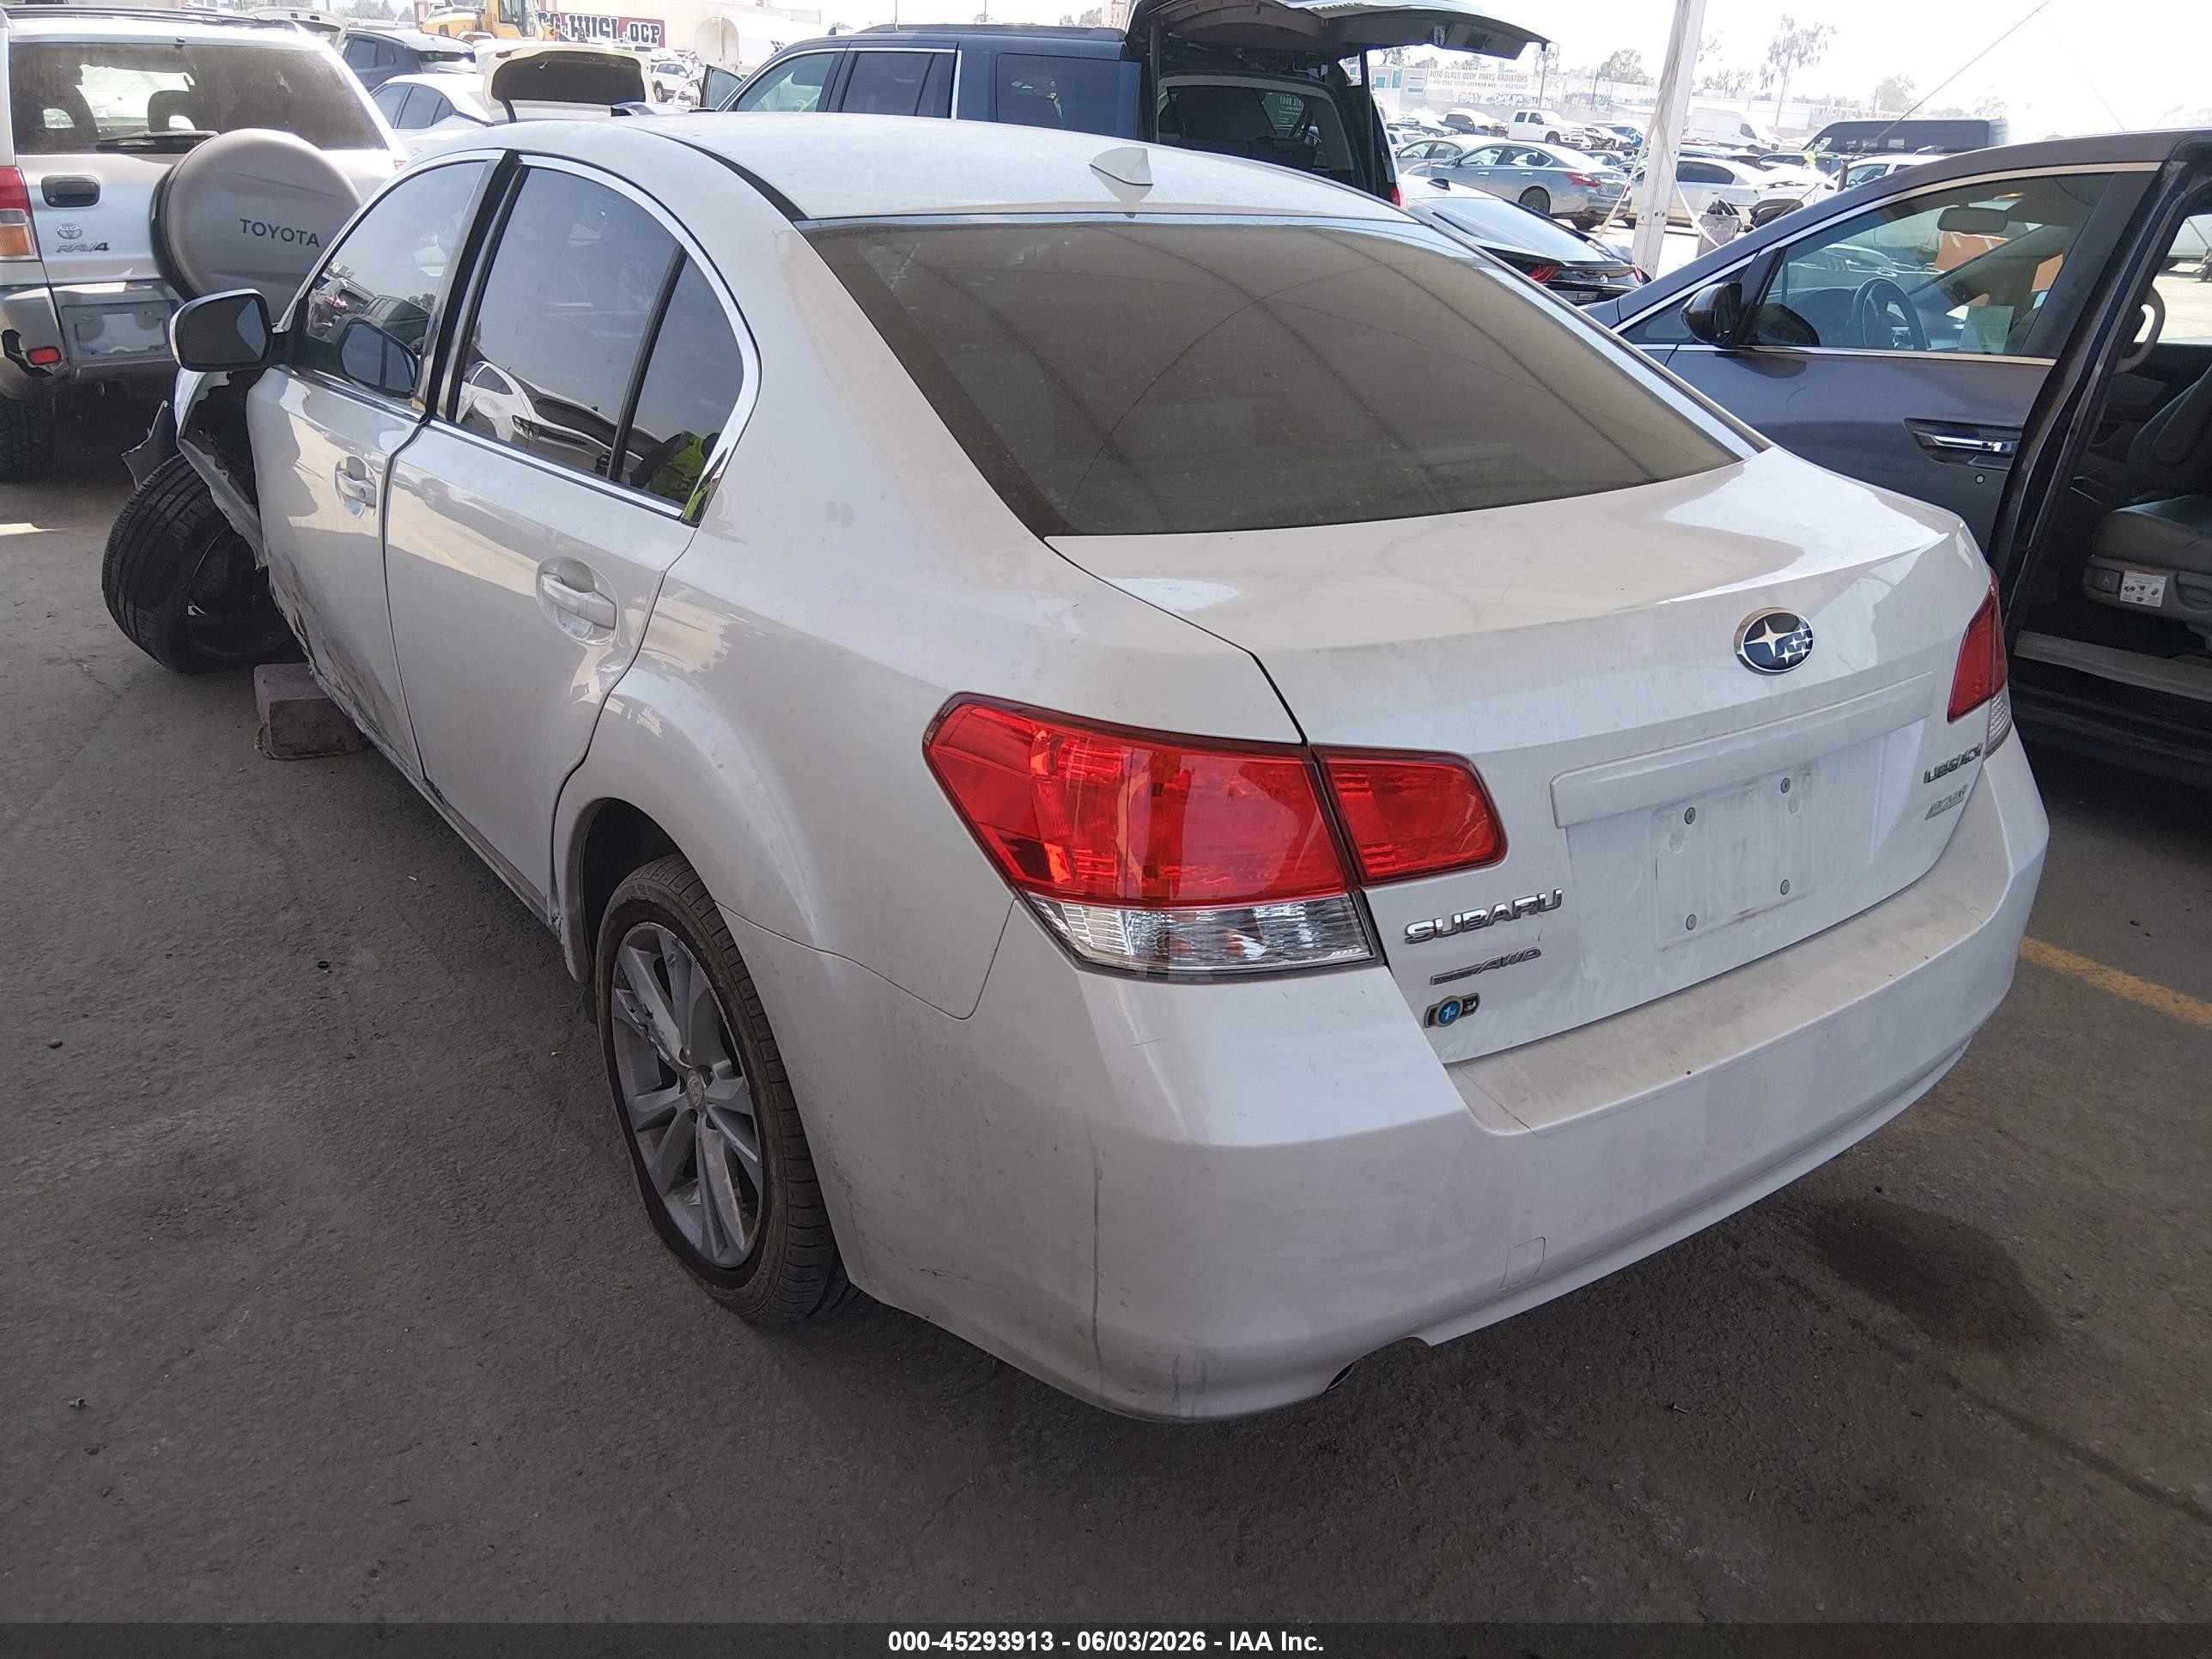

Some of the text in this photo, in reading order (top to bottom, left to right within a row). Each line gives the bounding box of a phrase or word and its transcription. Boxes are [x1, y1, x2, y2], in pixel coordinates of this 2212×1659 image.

[240, 218, 320, 248] TOYOTA
[56, 242, 110, 253] RAV4
[1404, 888, 1563, 945] SUBARU
[1475, 947, 1541, 974] AWD
